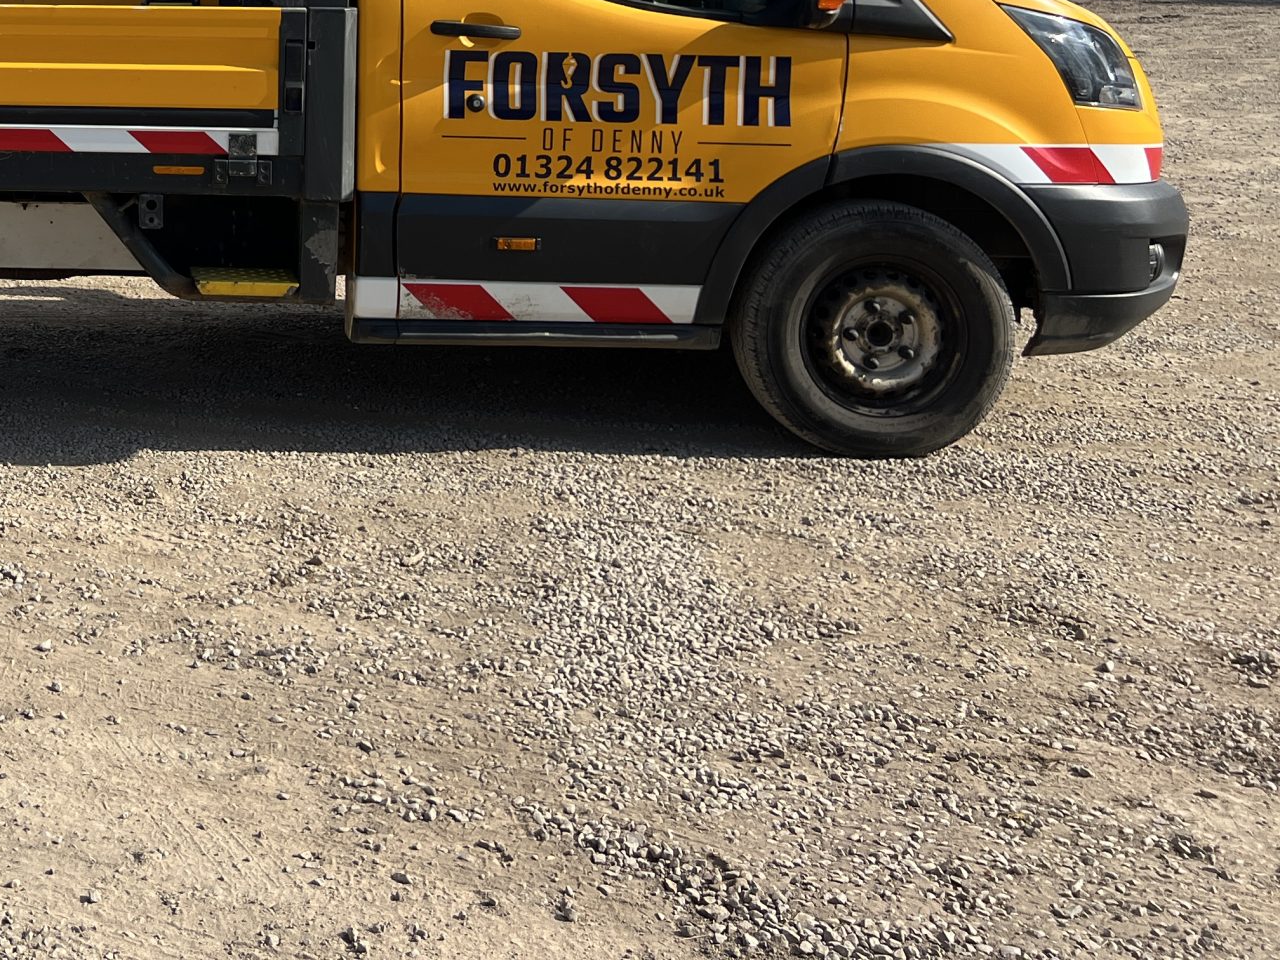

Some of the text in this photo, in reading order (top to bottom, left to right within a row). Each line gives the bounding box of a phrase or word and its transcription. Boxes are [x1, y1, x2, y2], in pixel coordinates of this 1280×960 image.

[443, 49, 792, 127] FORSYTH
[542, 127, 683, 154] OF DENNY
[493, 153, 724, 183] 01324 822141
[492, 181, 725, 199] www.forsythofdenny.co.uk
